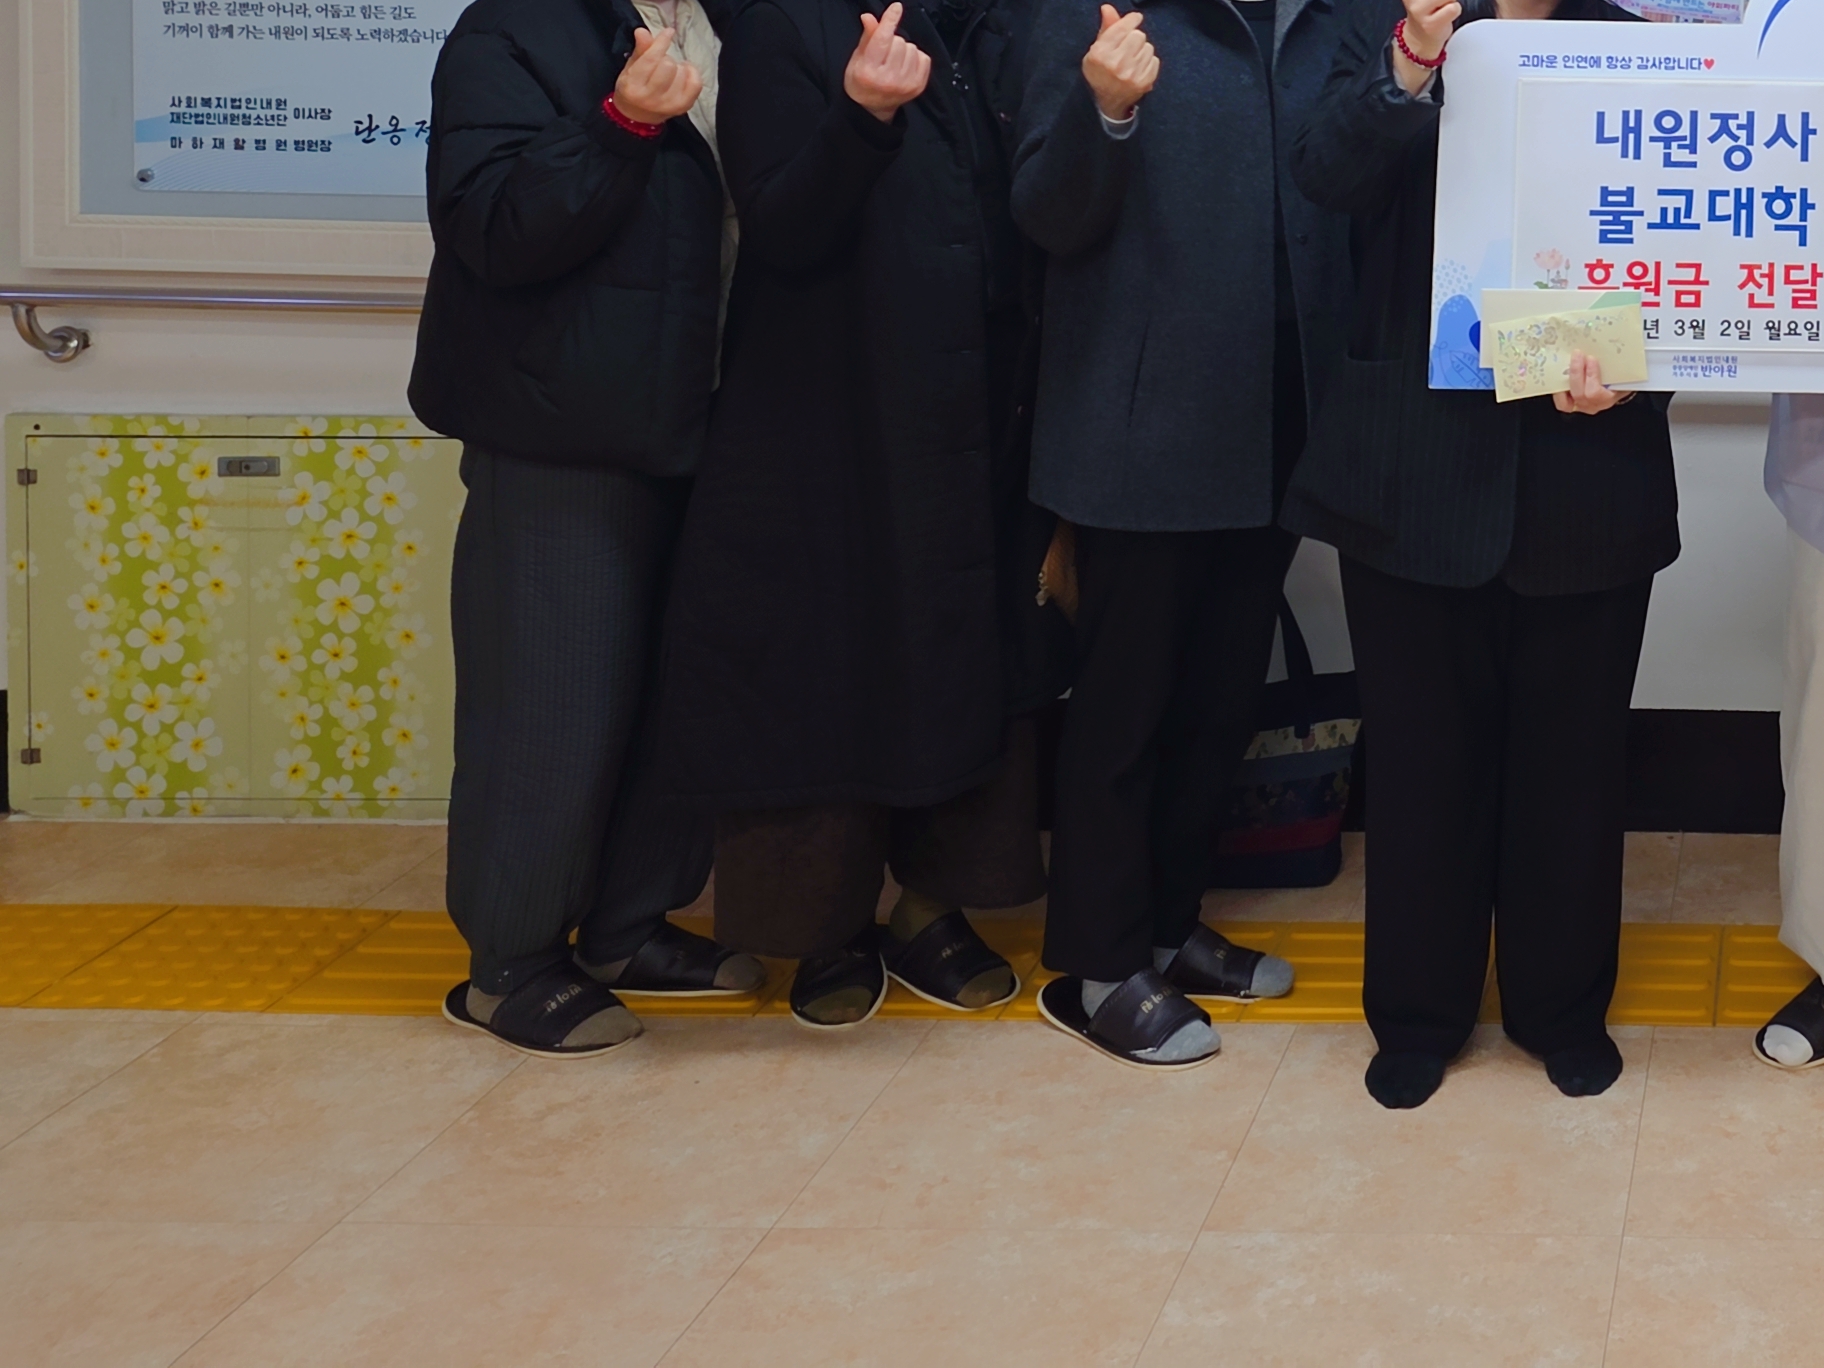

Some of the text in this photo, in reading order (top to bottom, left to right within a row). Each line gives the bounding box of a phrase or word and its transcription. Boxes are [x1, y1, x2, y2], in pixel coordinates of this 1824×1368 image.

[1518, 54, 1558, 68] 고마운
[1562, 55, 1602, 69] 인연에
[1606, 56, 1633, 70] 항상
[169, 112, 287, 127] 재단법인내원청소년단
[293, 108, 332, 121] 이사장
[293, 138, 332, 153] 병원장
[1595, 108, 1817, 172] 내원정사
[1589, 185, 1816, 247] 불교대학
[1737, 262, 1824, 309] 전달
[1674, 319, 1705, 340] 3월
[1719, 319, 1751, 341] 2일
[1763, 320, 1820, 341] 월요일
[1700, 364, 1737, 378] 반야원
